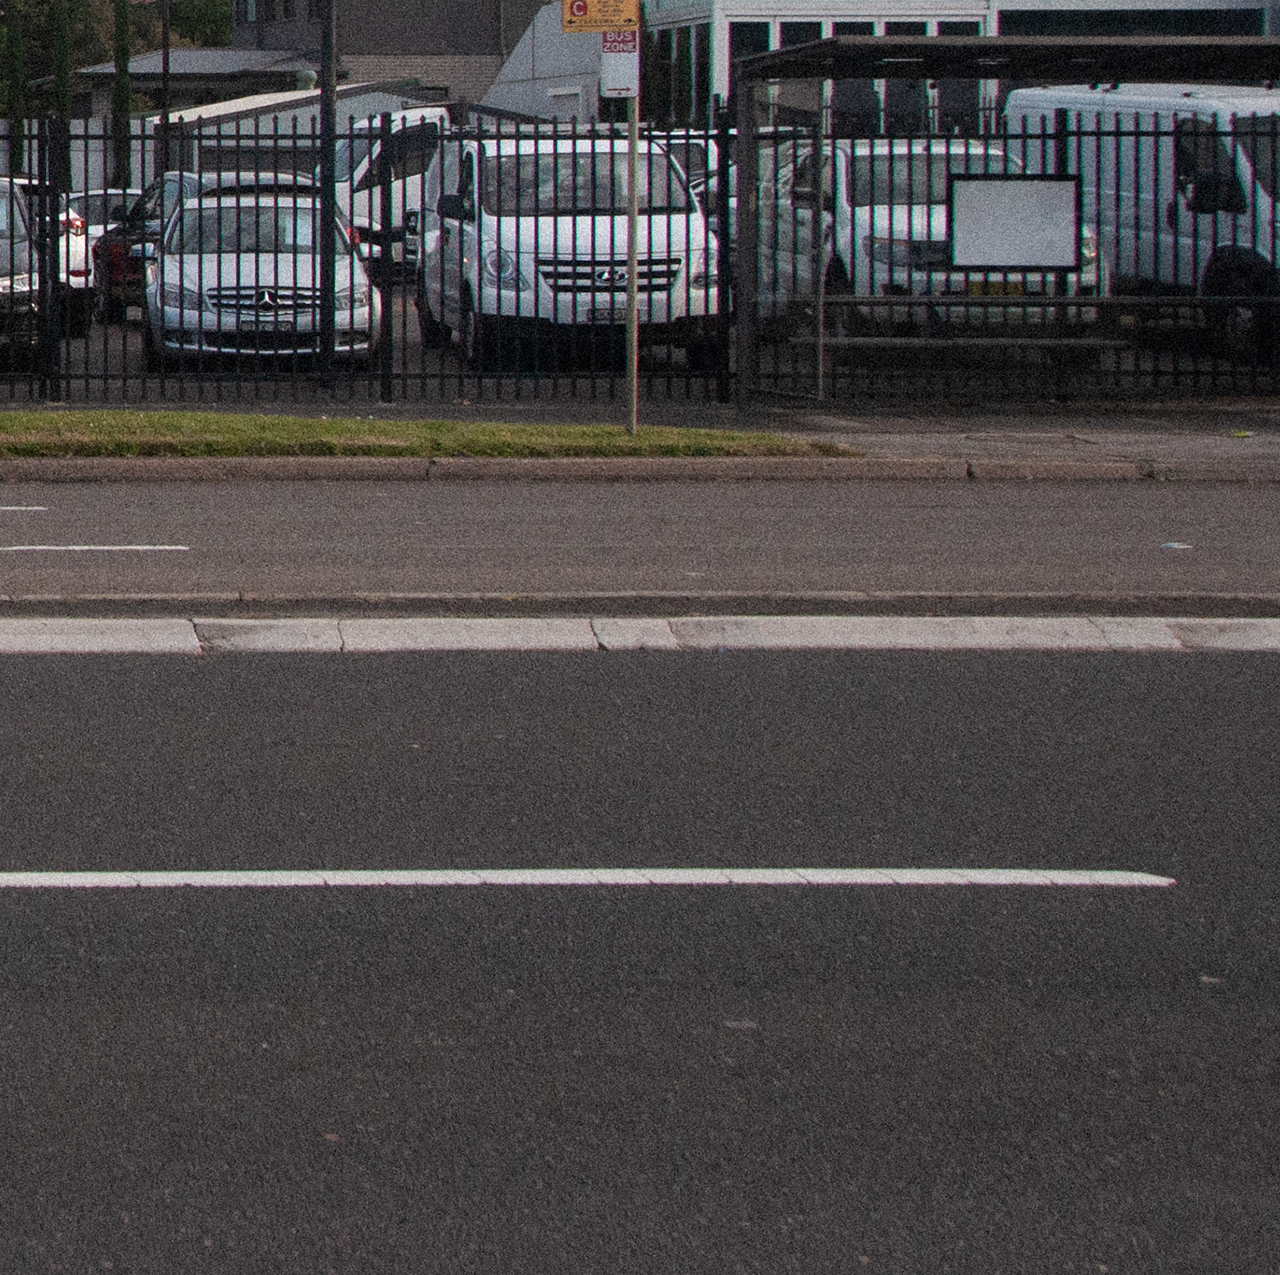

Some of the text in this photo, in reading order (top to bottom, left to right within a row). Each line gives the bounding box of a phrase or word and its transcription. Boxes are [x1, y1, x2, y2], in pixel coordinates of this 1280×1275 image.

[573, 1, 583, 16] C
[606, 31, 632, 41] BUS
[603, 42, 636, 53] ZONE
